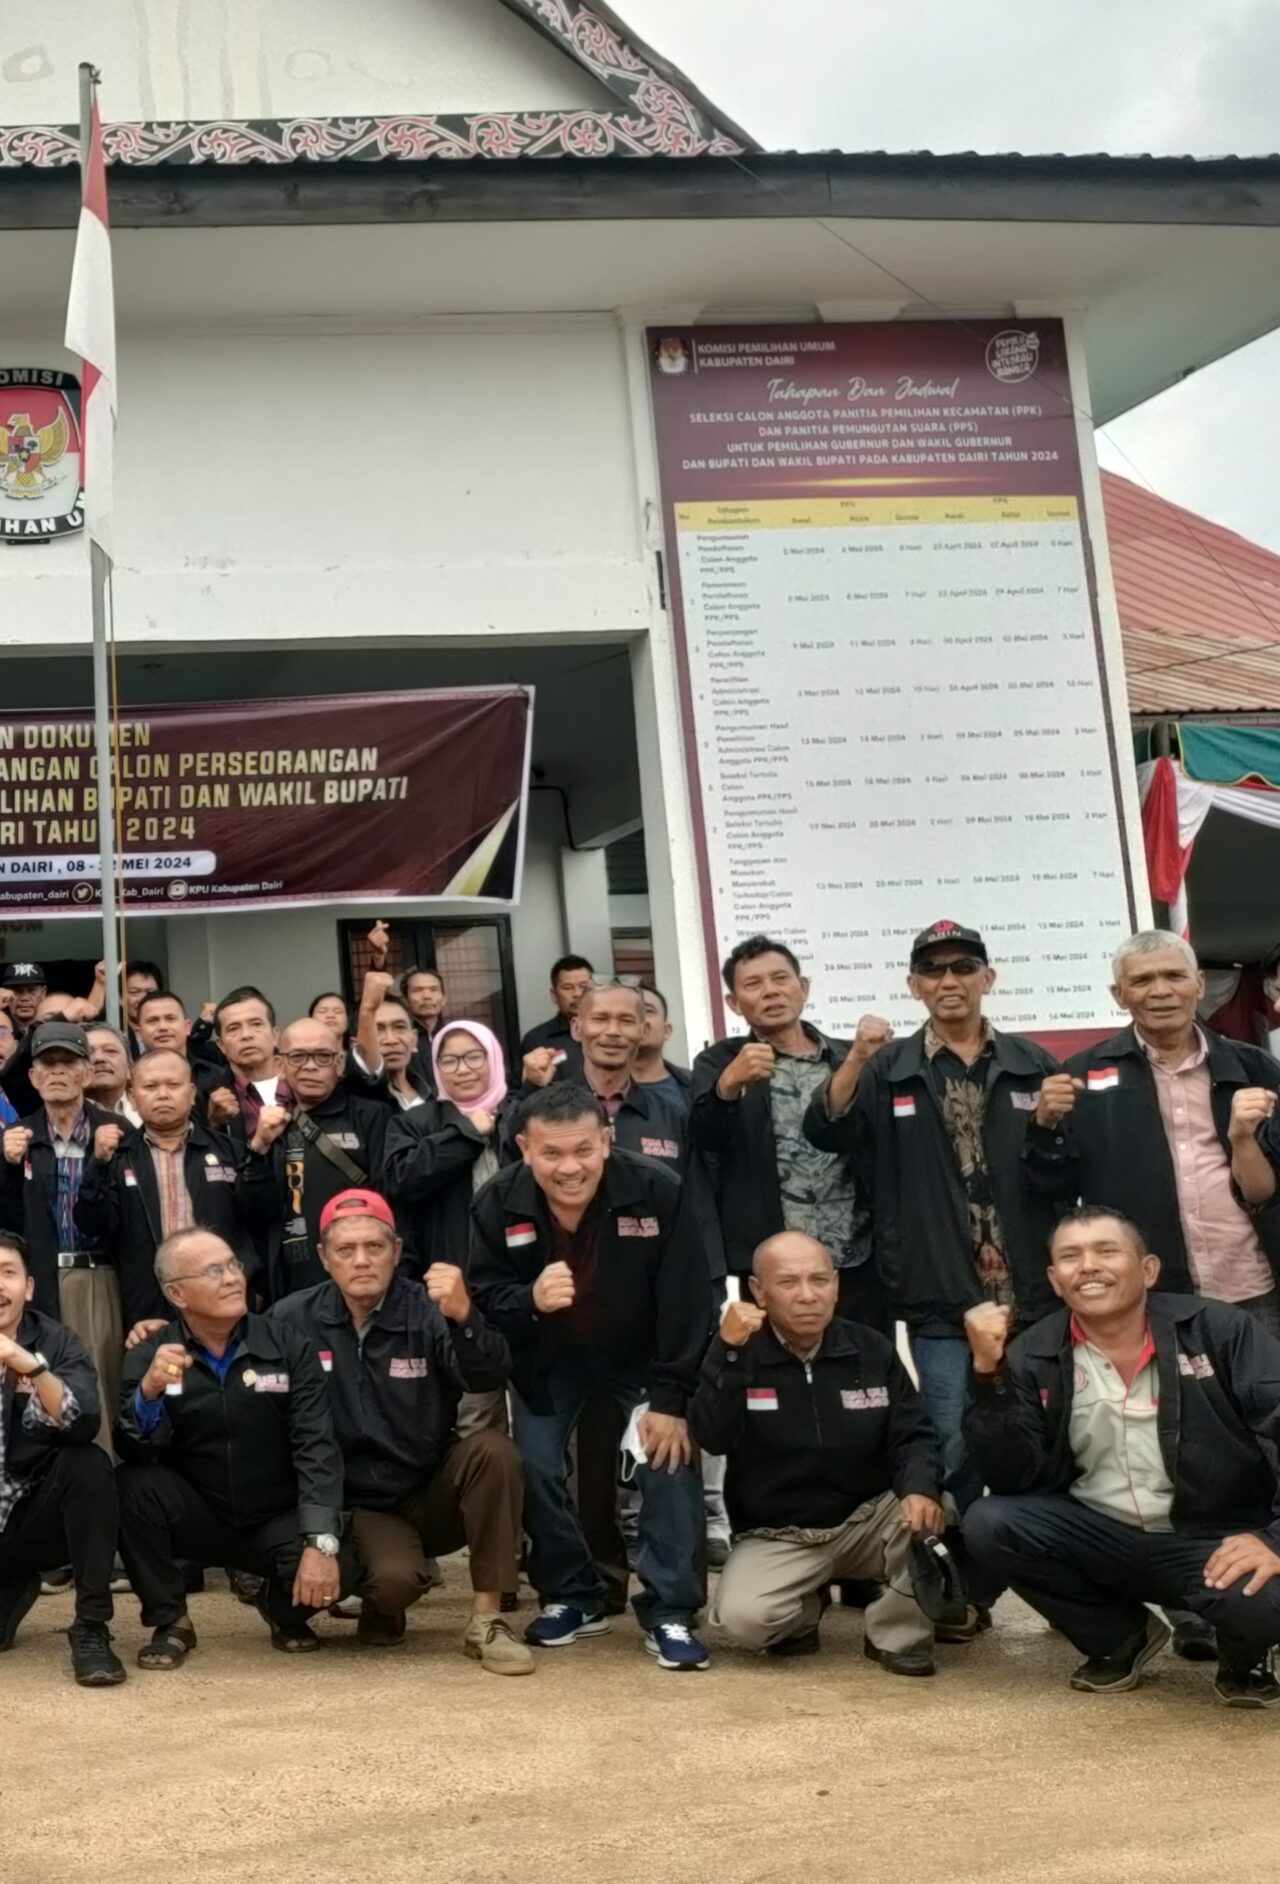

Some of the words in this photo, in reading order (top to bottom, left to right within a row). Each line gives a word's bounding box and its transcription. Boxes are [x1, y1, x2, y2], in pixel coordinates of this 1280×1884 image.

[698, 343, 736, 354] KOMISI
[738, 342, 798, 353] PEMILIHAN
[800, 341, 836, 351] UMUM
[699, 356, 763, 367] KABUPATEN
[765, 355, 795, 366] DAIRI
[689, 412, 734, 423] SELEKSI
[736, 411, 774, 422] CALON
[777, 410, 831, 421] ANGGOTA
[834, 409, 878, 419] PANITIA
[881, 407, 940, 418] PEMILIHAN
[942, 406, 1010, 417] KECAMATAN
[1012, 404, 1042, 417] (PPK)
[759, 426, 782, 436] DAN
[785, 425, 830, 436] PANITIA
[833, 423, 908, 434] PEMUNGUTAN
[911, 422, 946, 433] SUARA
[949, 421, 979, 434] (PPS)
[727, 442, 765, 453] UNTUK
[768, 441, 828, 452] PEMILIHAN
[831, 439, 889, 450] GUBERNUR
[892, 438, 915, 449] DAN
[917, 437, 953, 448] WAKIL
[955, 436, 1012, 447] GUBERNUR
[683, 459, 706, 470] DAN
[709, 458, 749, 469] BUPATI
[752, 457, 775, 468] DAN
[778, 456, 813, 467] WAKIL
[816, 455, 856, 465] BUPATI
[859, 454, 889, 464] PADA
[891, 452, 956, 463] KABUPATEN
[958, 451, 988, 462] DAIRI
[991, 450, 1029, 461] TAHUN
[1031, 449, 1058, 461] 2024
[66, 491, 85, 527] UM
[179, 747, 378, 778] PERSEORANGAN
[84, 784, 171, 812] BPATI
[180, 782, 230, 809] DAN
[238, 780, 317, 807] WAKIL
[323, 776, 408, 805] BUPATI
[33, 817, 114, 845] TAHU
[125, 815, 196, 842] 2024
[11, 861, 53, 874] DAIRI
[66, 860, 85, 872] 08
[121, 859, 149, 871] MEI
[154, 857, 192, 869] 2024
[189, 885, 209, 895] KPU
[211, 883, 260, 895] Kabupaten
[262, 881, 283, 891] Dairi
